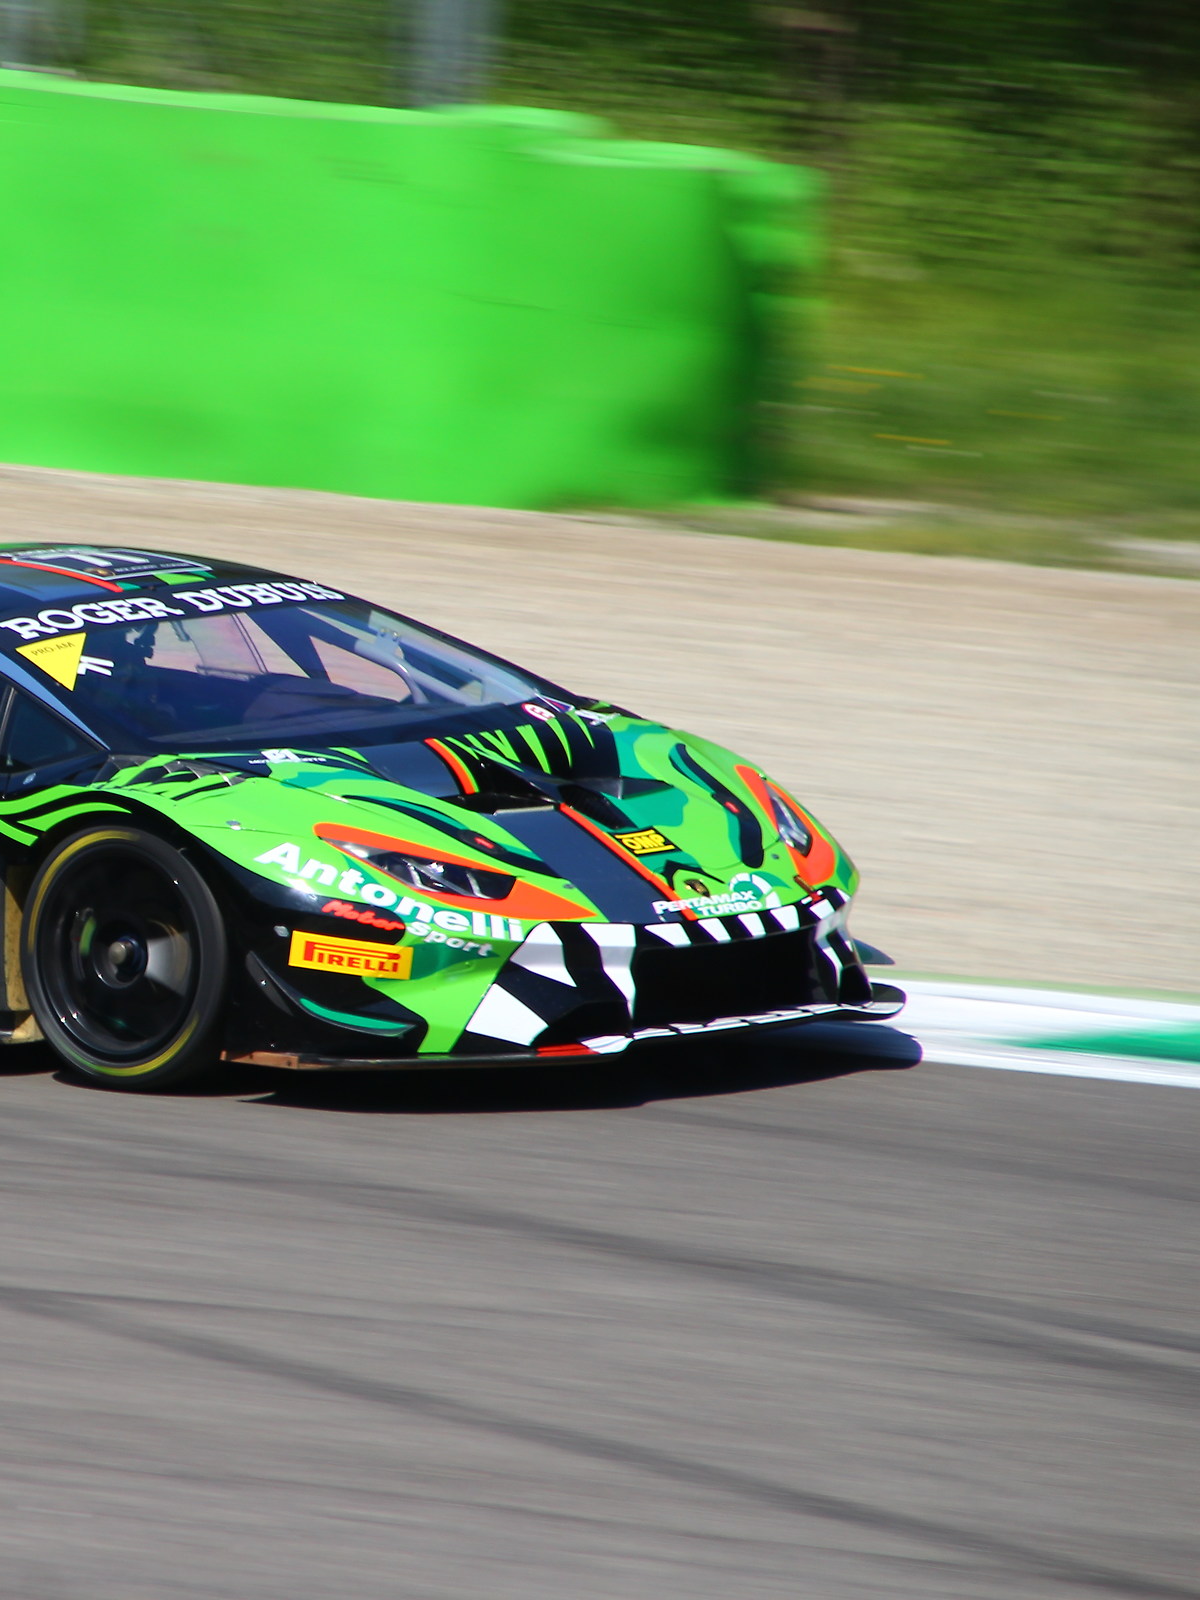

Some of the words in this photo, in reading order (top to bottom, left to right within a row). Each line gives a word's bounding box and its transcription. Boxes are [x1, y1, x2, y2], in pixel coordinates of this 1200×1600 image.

[172, 582, 346, 612] DUBUIS
[620, 832, 668, 851] OMP
[253, 842, 525, 942] Antonelli
[652, 890, 757, 914] PERTAMAX
[321, 899, 405, 931] Motor
[698, 900, 763, 916] TURBO
[303, 940, 402, 973] PIRELLI
